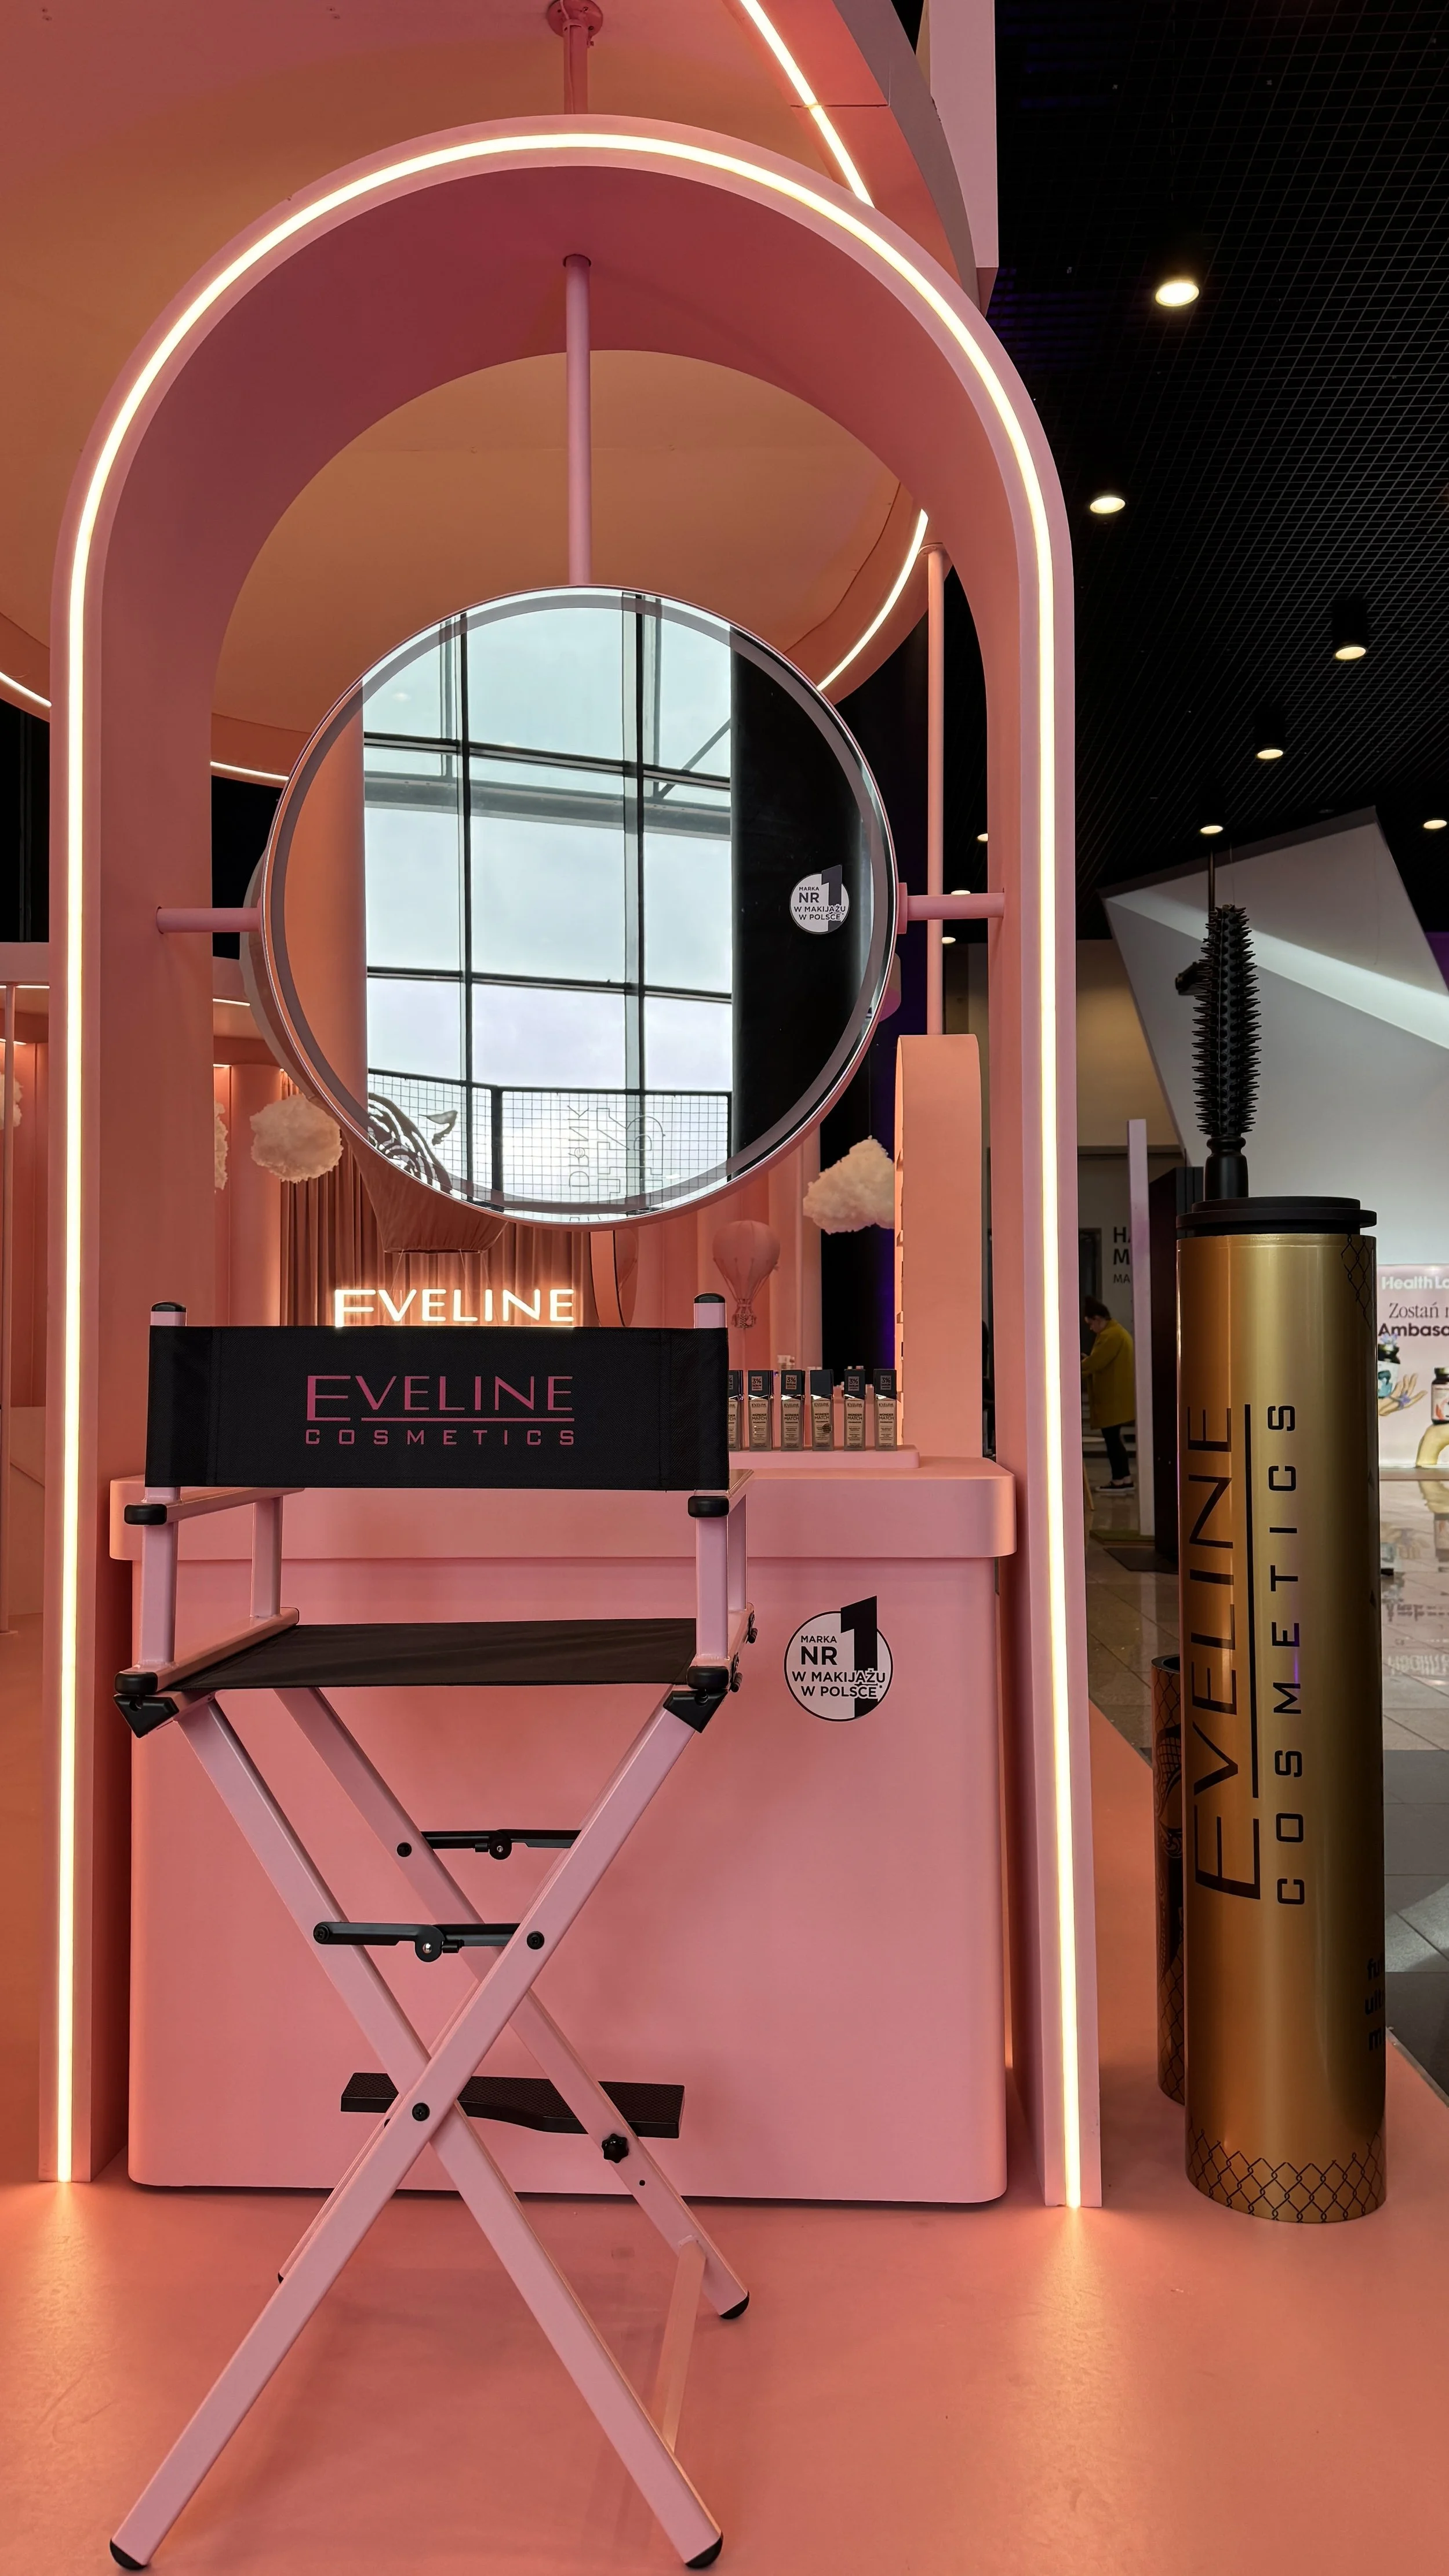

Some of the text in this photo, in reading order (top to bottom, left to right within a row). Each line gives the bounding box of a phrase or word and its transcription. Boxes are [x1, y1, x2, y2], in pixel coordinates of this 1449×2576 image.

[799, 892, 820, 903] NR
[1113, 1227, 1131, 1243] H
[1389, 1301, 1439, 1319] Zostań
[307, 1376, 574, 1421] EVELINE
[305, 1429, 574, 1446] COSMETICS
[801, 1595, 878, 1719] NR 1
[1188, 1406, 1261, 1901] EVELINE
[1268, 1405, 1305, 1905] COSMETICS
[792, 1669, 886, 1683] W MAKIJAŻU
[801, 1686, 815, 1696] W
